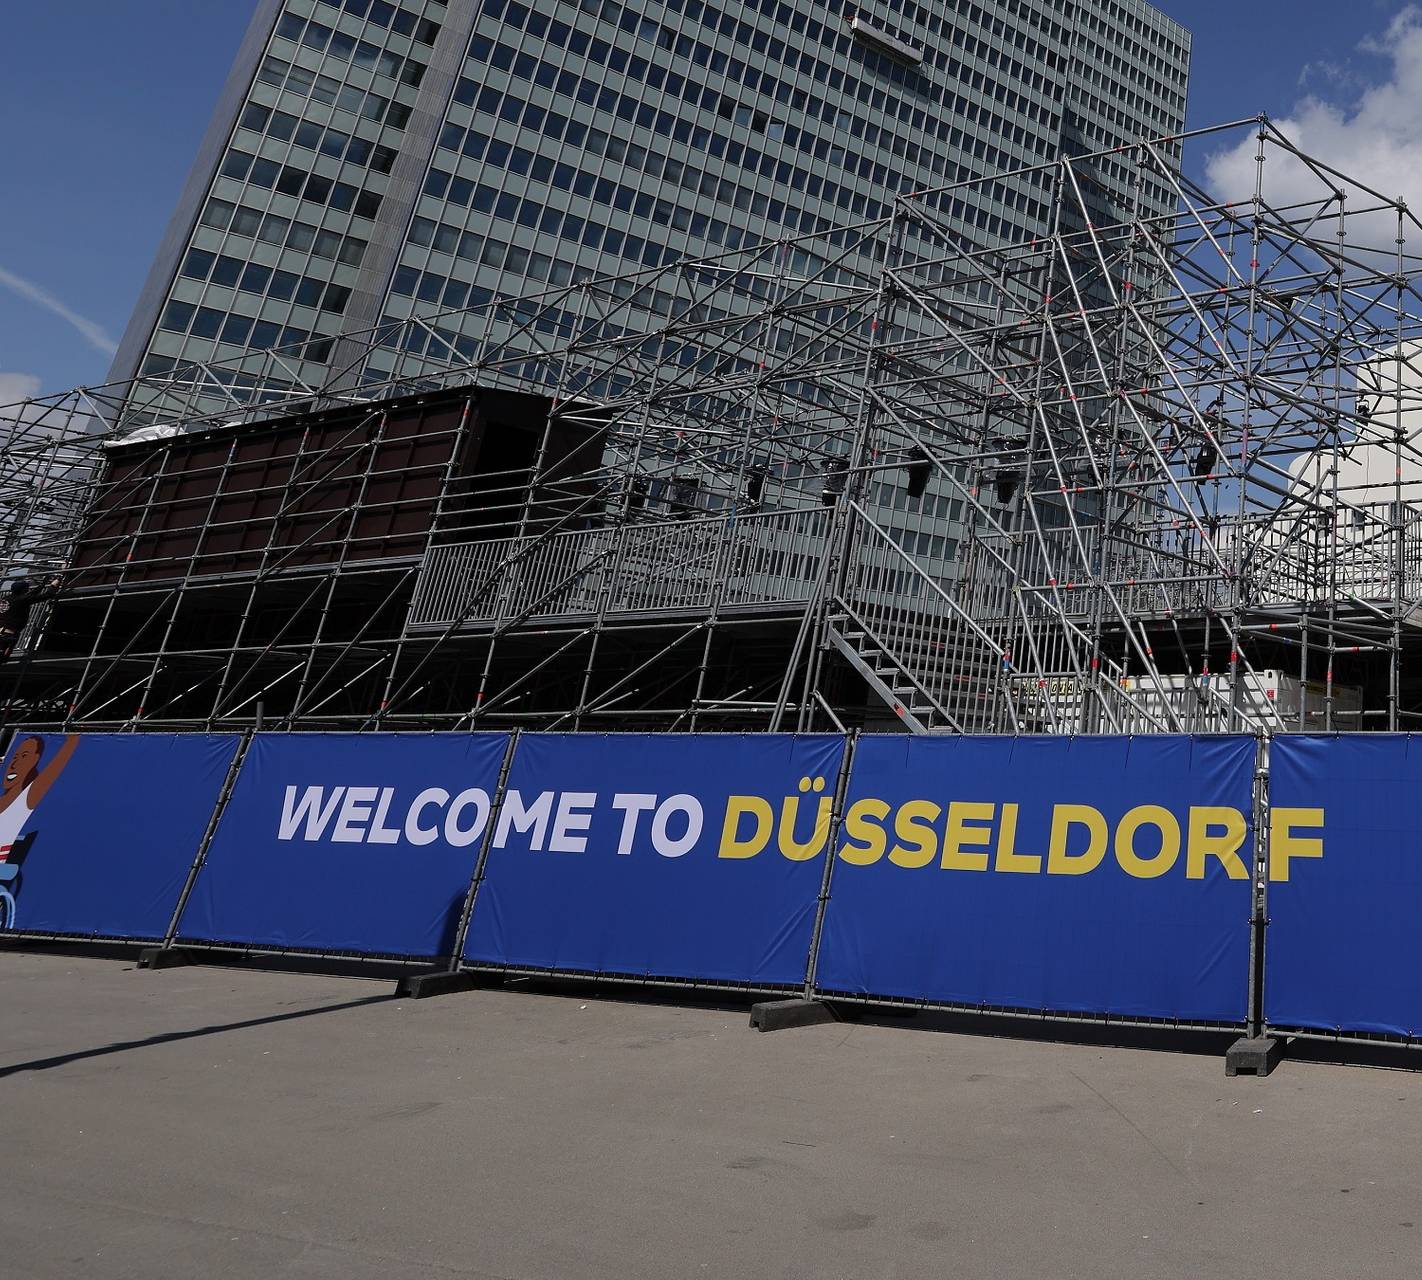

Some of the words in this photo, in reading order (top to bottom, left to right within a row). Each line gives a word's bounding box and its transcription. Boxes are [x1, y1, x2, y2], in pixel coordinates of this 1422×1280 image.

[277, 785, 597, 853] WELCOME
[612, 793, 704, 858] TO
[718, 776, 1325, 882] DÜSSELDORF
